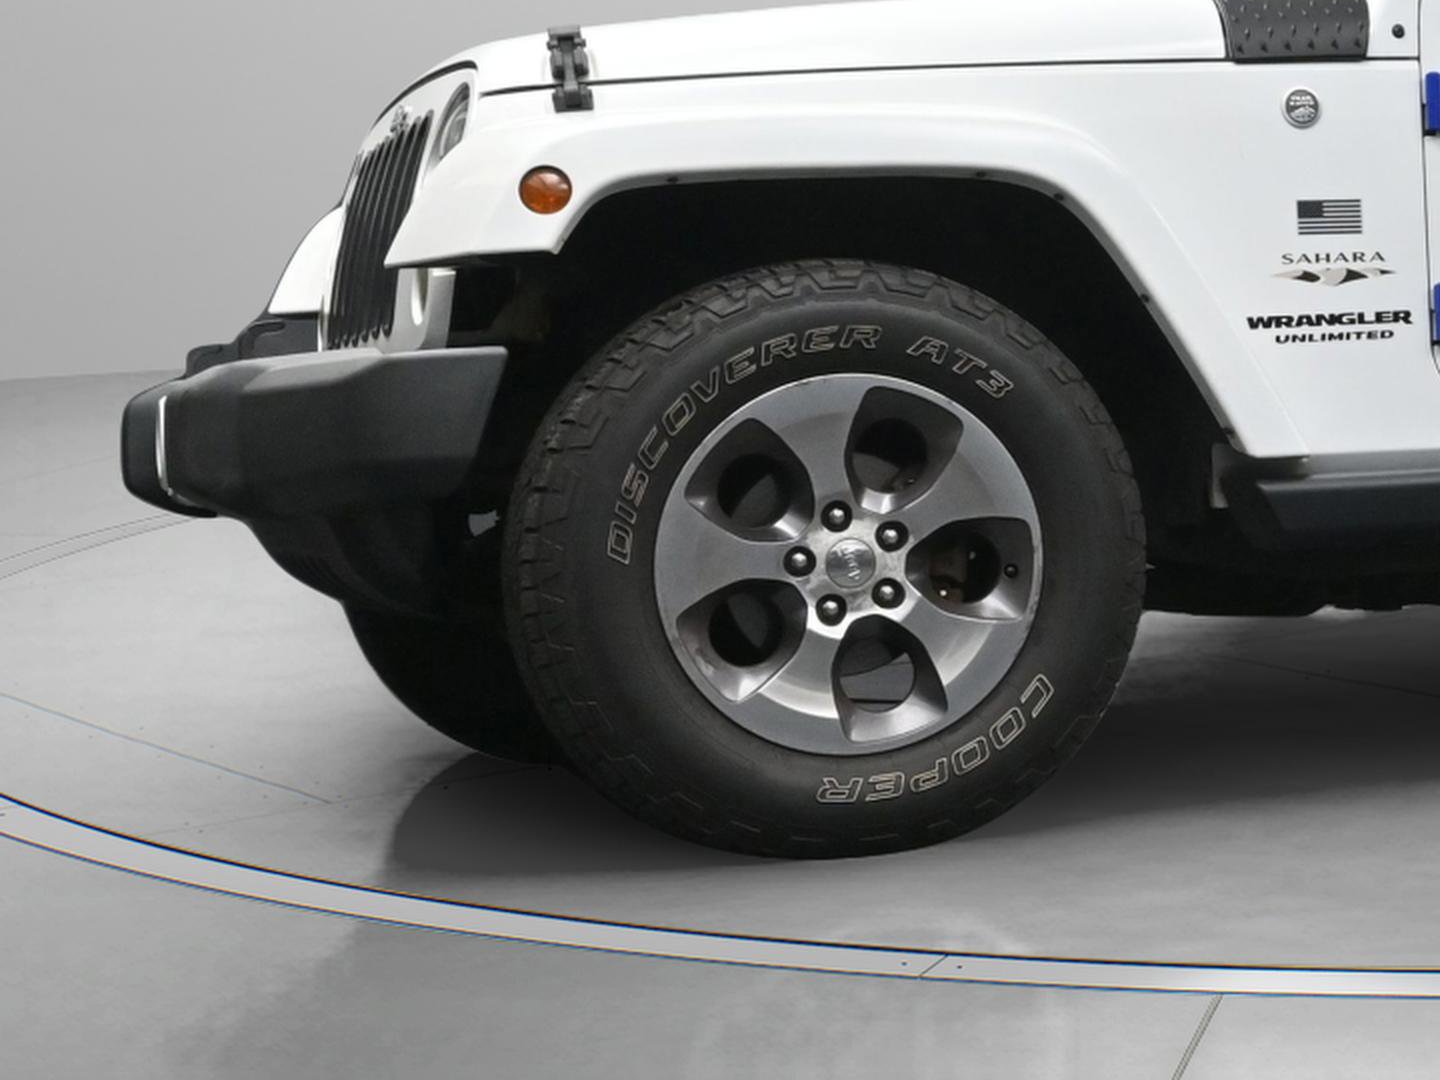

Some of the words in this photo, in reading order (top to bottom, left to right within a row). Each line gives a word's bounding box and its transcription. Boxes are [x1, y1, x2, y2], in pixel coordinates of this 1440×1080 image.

[1281, 251, 1386, 265] SAHARA
[1246, 309, 1413, 330] WRANGLER
[1275, 330, 1395, 344] UNLIMITED
[606, 325, 883, 566] DISCOVERER
[907, 334, 1015, 400] AT3
[815, 673, 1055, 804] COOPER
